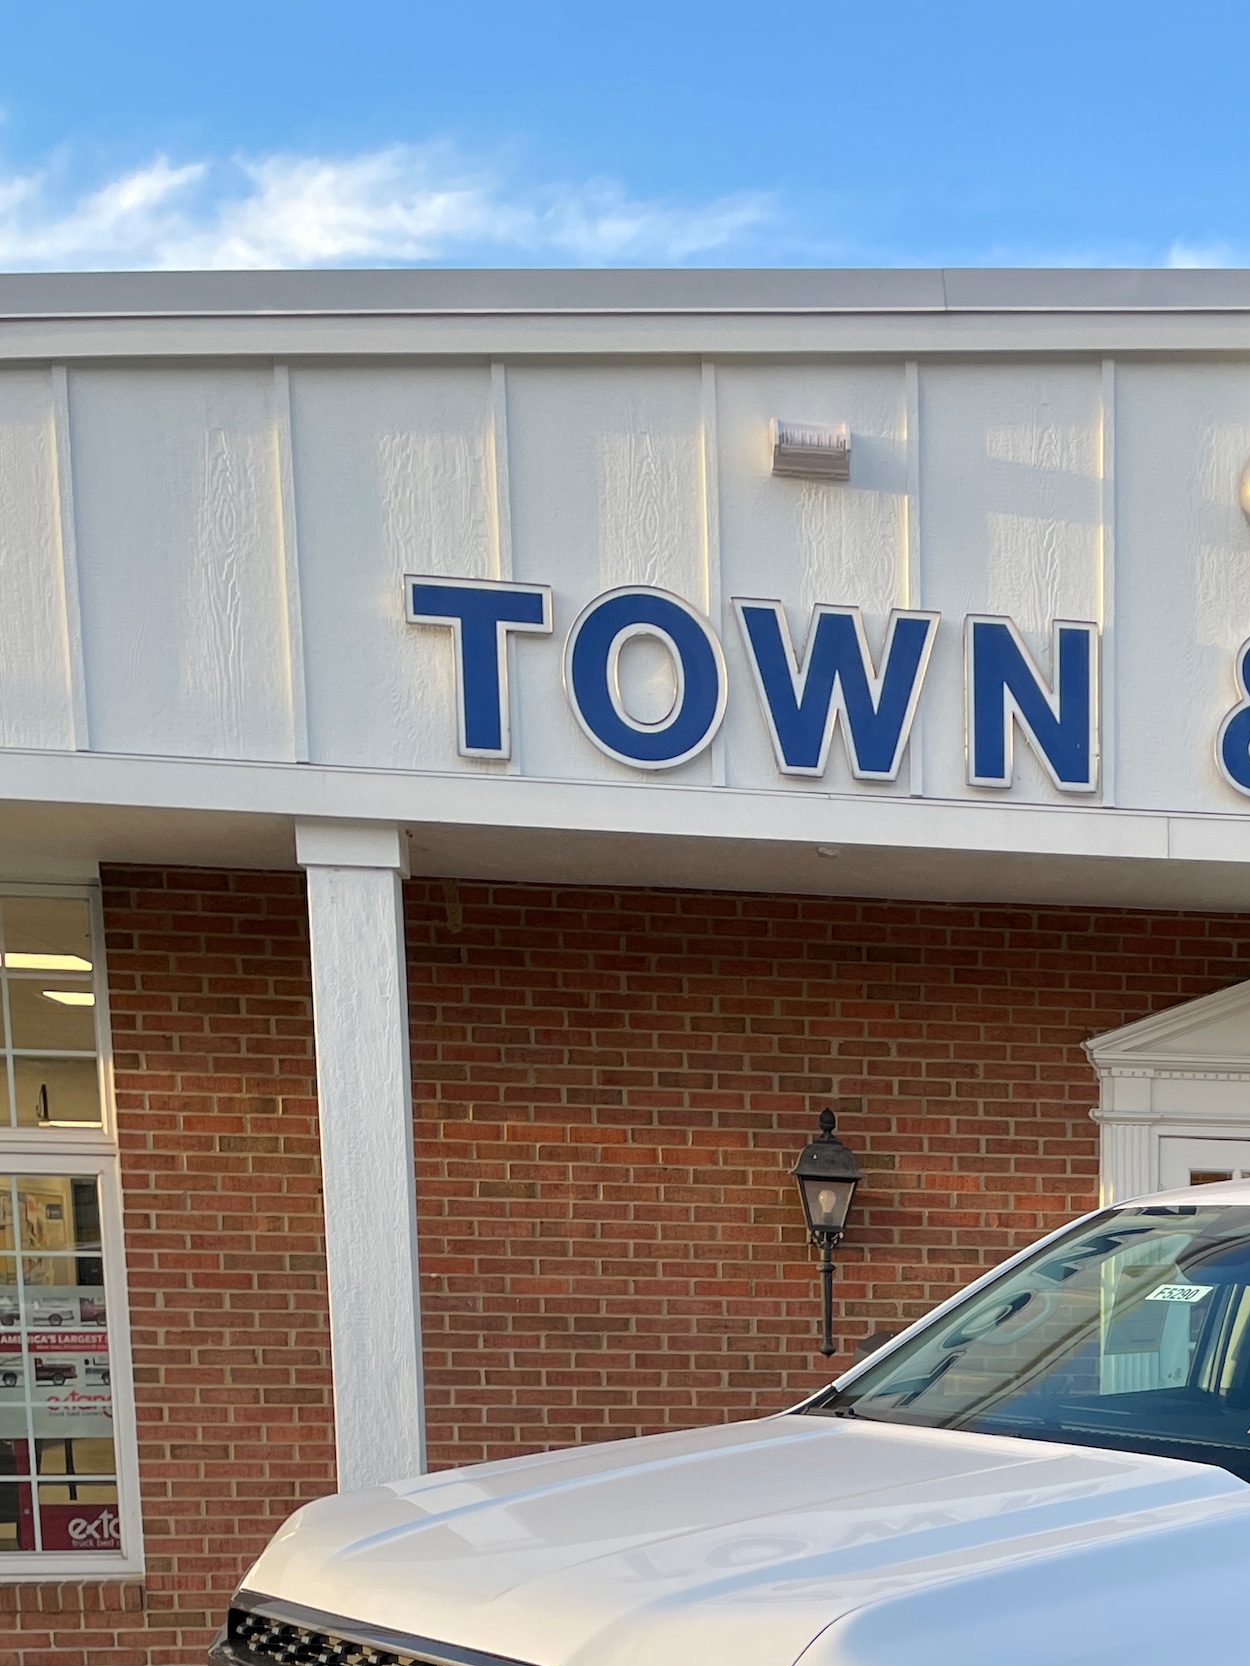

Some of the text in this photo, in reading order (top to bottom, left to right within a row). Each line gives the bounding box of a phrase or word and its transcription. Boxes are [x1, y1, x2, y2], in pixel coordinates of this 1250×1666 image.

[404, 574, 1101, 793] TOWN
[1153, 1287, 1200, 1300] F5290
[58, 1334, 103, 1344] LARGEST
[71, 1539, 95, 1548] truck
[96, 1539, 115, 1548] bed
